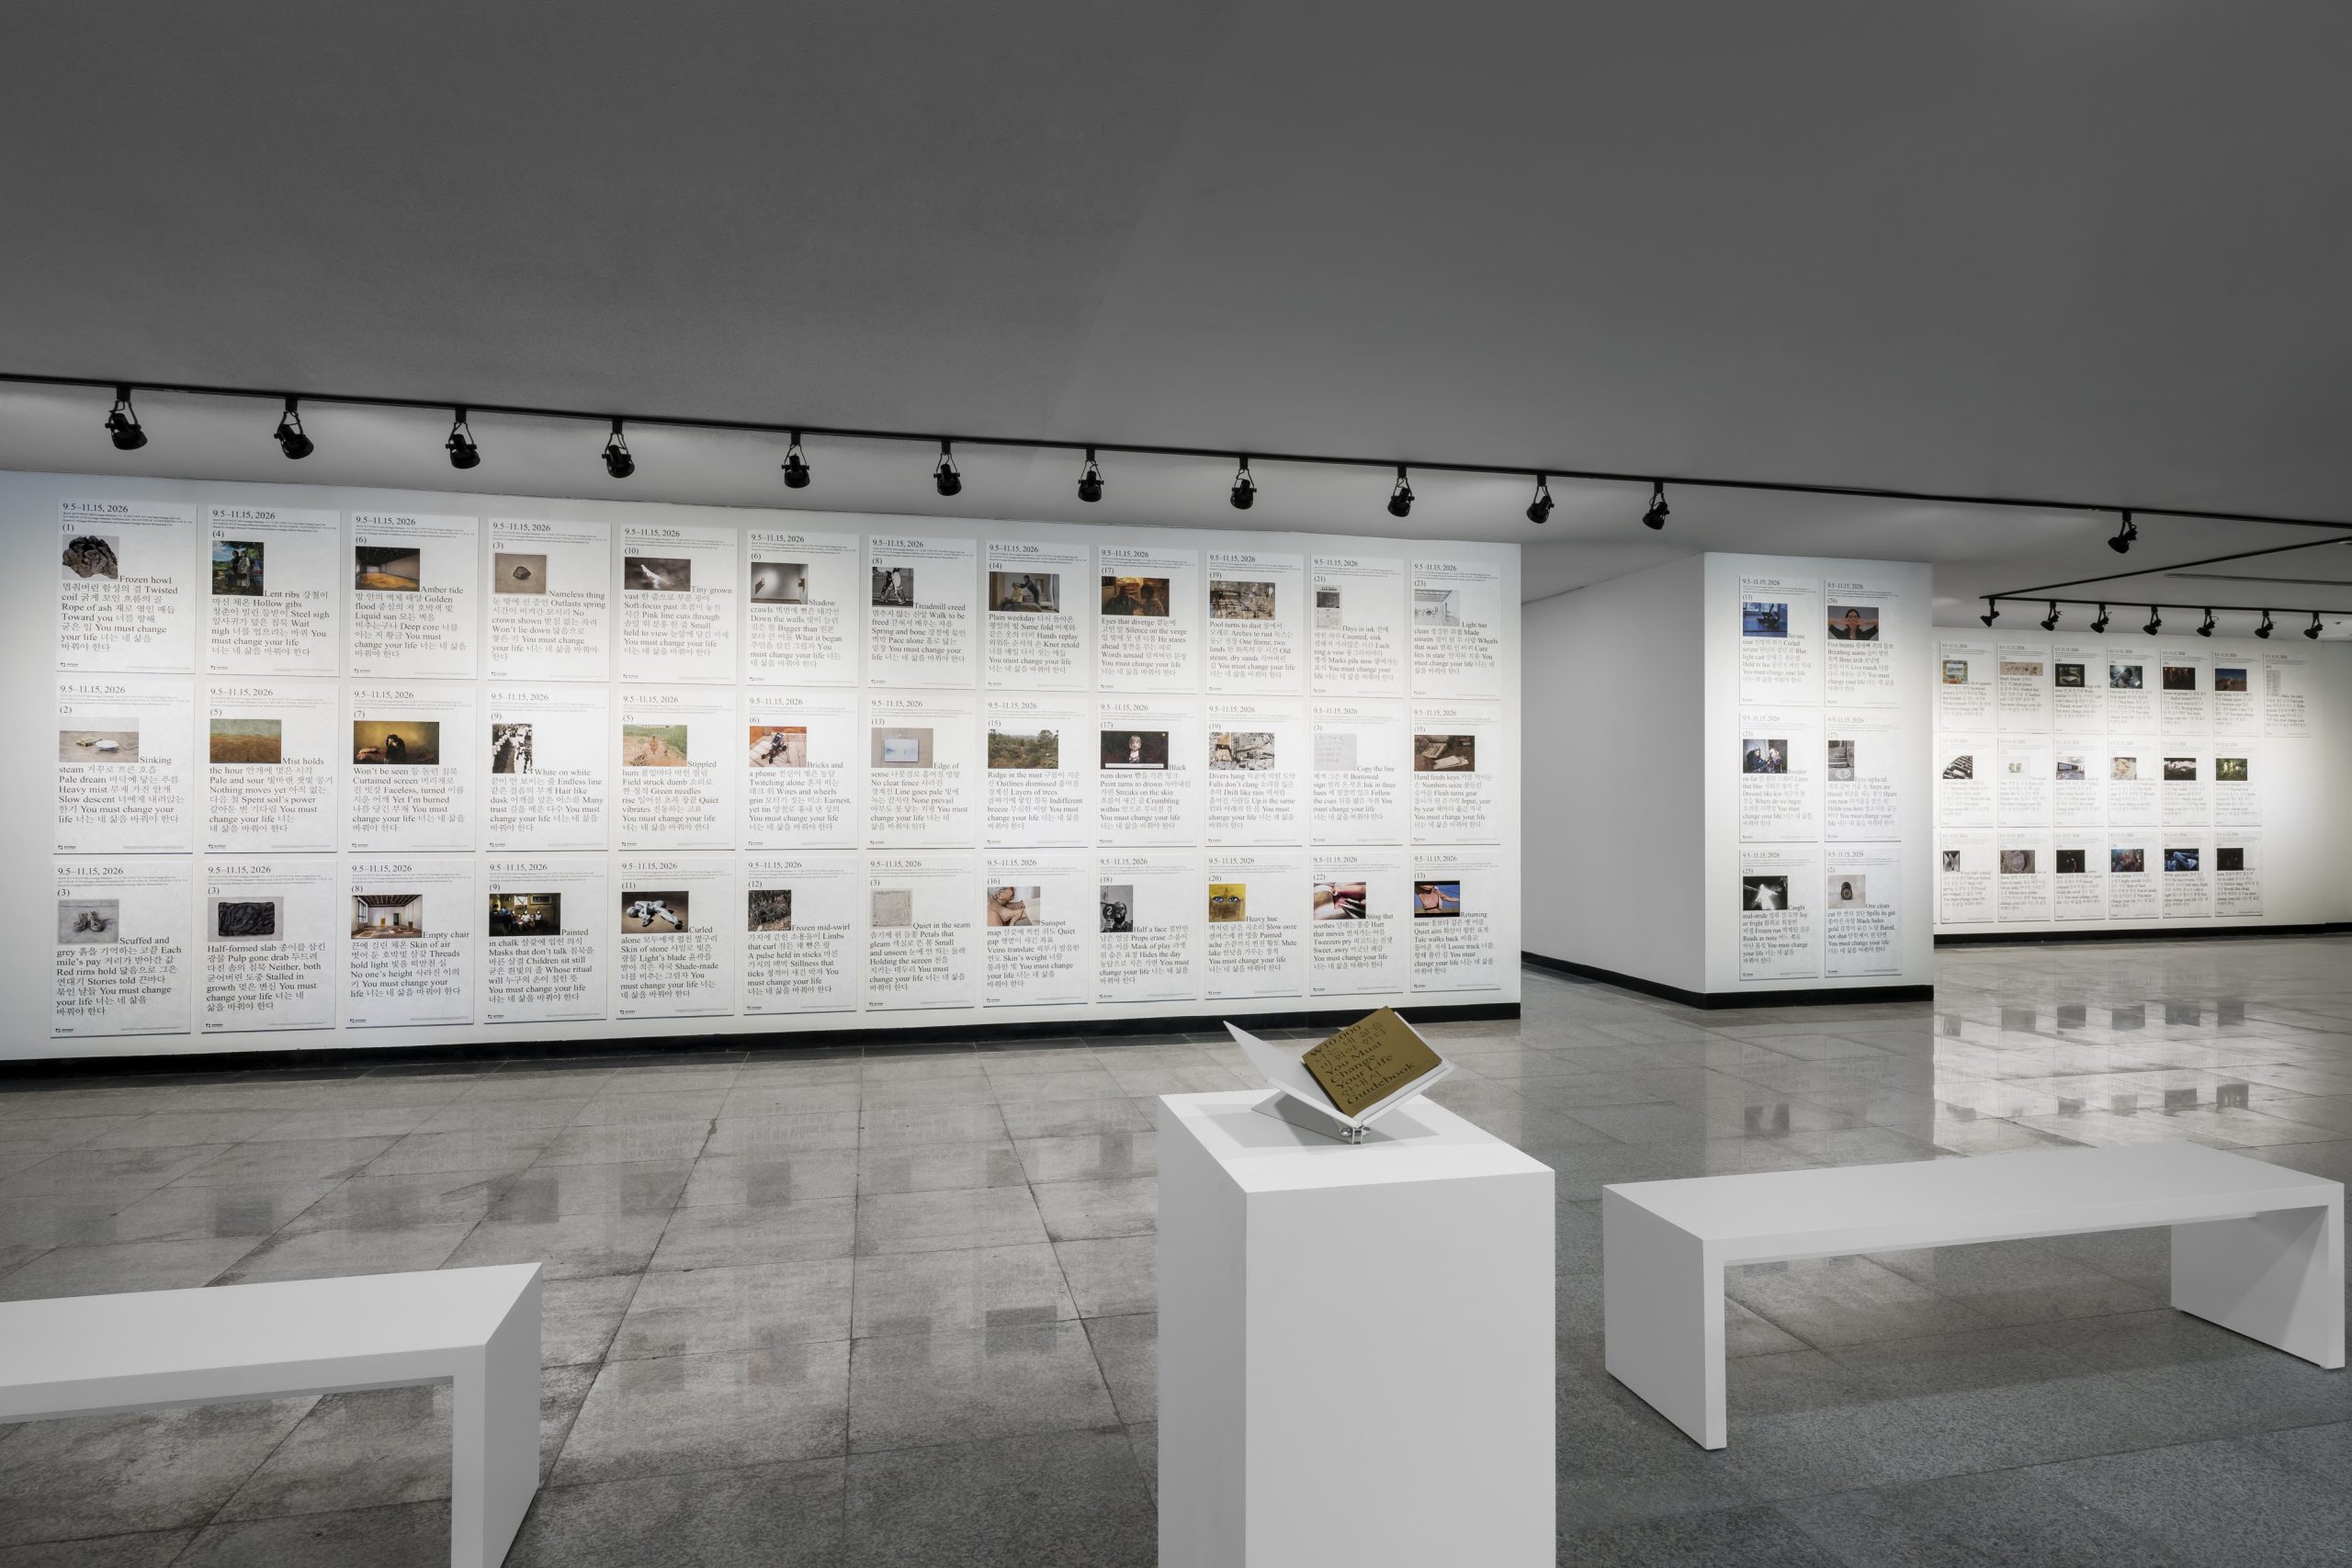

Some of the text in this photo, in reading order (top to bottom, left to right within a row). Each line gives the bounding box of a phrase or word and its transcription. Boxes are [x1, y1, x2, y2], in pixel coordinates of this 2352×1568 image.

[107, 504, 128, 513] 2026
[62, 524, 74, 532] (1)
[872, 557, 882, 565] (8)
[143, 585, 177, 593] Twisted
[263, 589, 300, 598] Lent ribs
[690, 585, 707, 595] Tiny
[61, 592, 77, 601] coil
[548, 590, 605, 600] Nameless thing
[61, 603, 85, 613] Rope
[61, 613, 95, 621] Toward
[1006, 614, 1035, 624] weekday
[1101, 616, 1116, 626] Eyes
[1131, 618, 1154, 626] diverge
[95, 623, 111, 631] You
[136, 625, 166, 634] change
[60, 634, 81, 643] your
[100, 633, 118, 641] 너는
[91, 642, 110, 651] 한다
[104, 685, 125, 694] 2026
[138, 756, 172, 765] Sinking
[686, 760, 717, 770] Stippled
[933, 761, 950, 771] Edge
[988, 771, 1007, 779] Ridge
[207, 886, 220, 895] (3)
[911, 921, 931, 931] Quiet
[1039, 919, 1066, 928] Sunspot
[118, 936, 152, 944] Scuffed
[422, 931, 448, 940] Empty
[1324, 1041, 1383, 1076] You Must
[1330, 1055, 1376, 1084] Change
[1336, 1054, 1394, 1089] Your Life
[1341, 1070, 1383, 1097] 안내서
[1347, 1063, 1416, 1105] Guidebook
